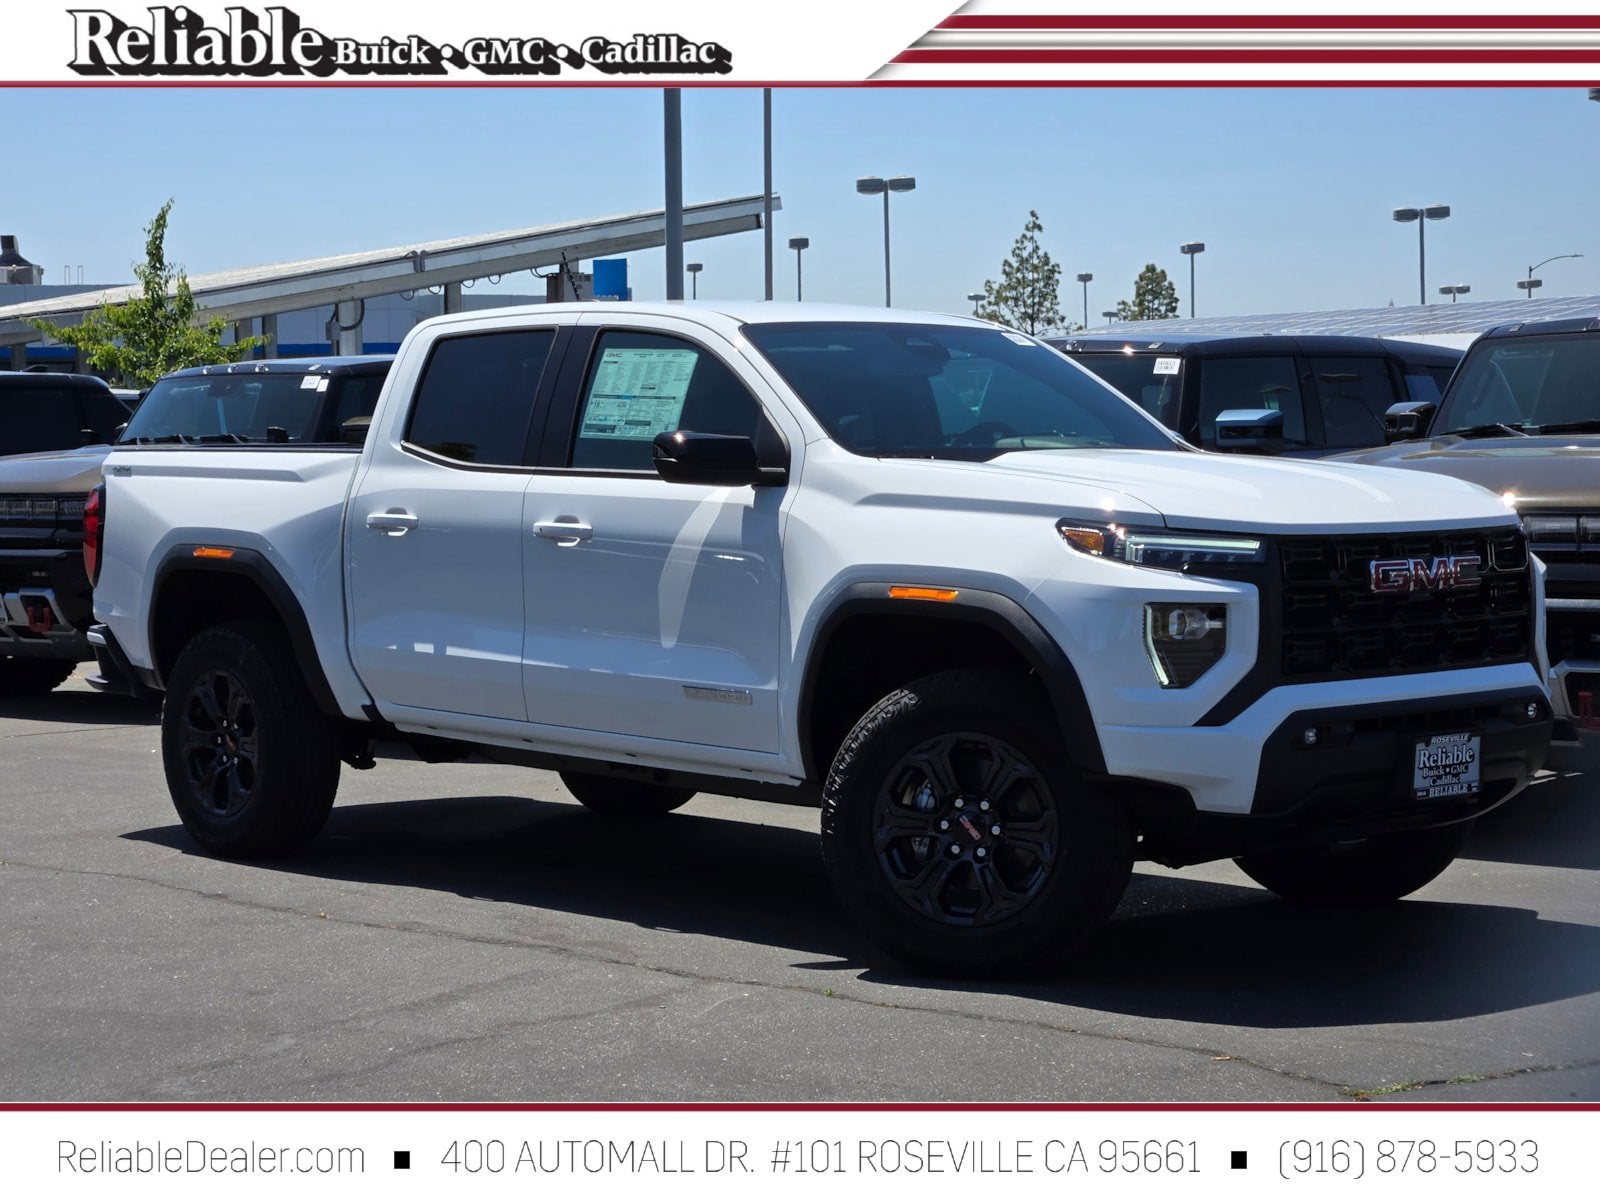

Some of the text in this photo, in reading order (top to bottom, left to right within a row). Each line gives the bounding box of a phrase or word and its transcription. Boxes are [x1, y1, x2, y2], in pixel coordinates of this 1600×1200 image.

[1370, 556, 1481, 593] GMC
[1431, 734, 1469, 743] ROSEVILLE
[1419, 744, 1474, 768] Reliable
[1422, 764, 1468, 778] Buick GMC
[1430, 775, 1460, 787] Cadillac
[1429, 784, 1468, 797] RELIABLE
